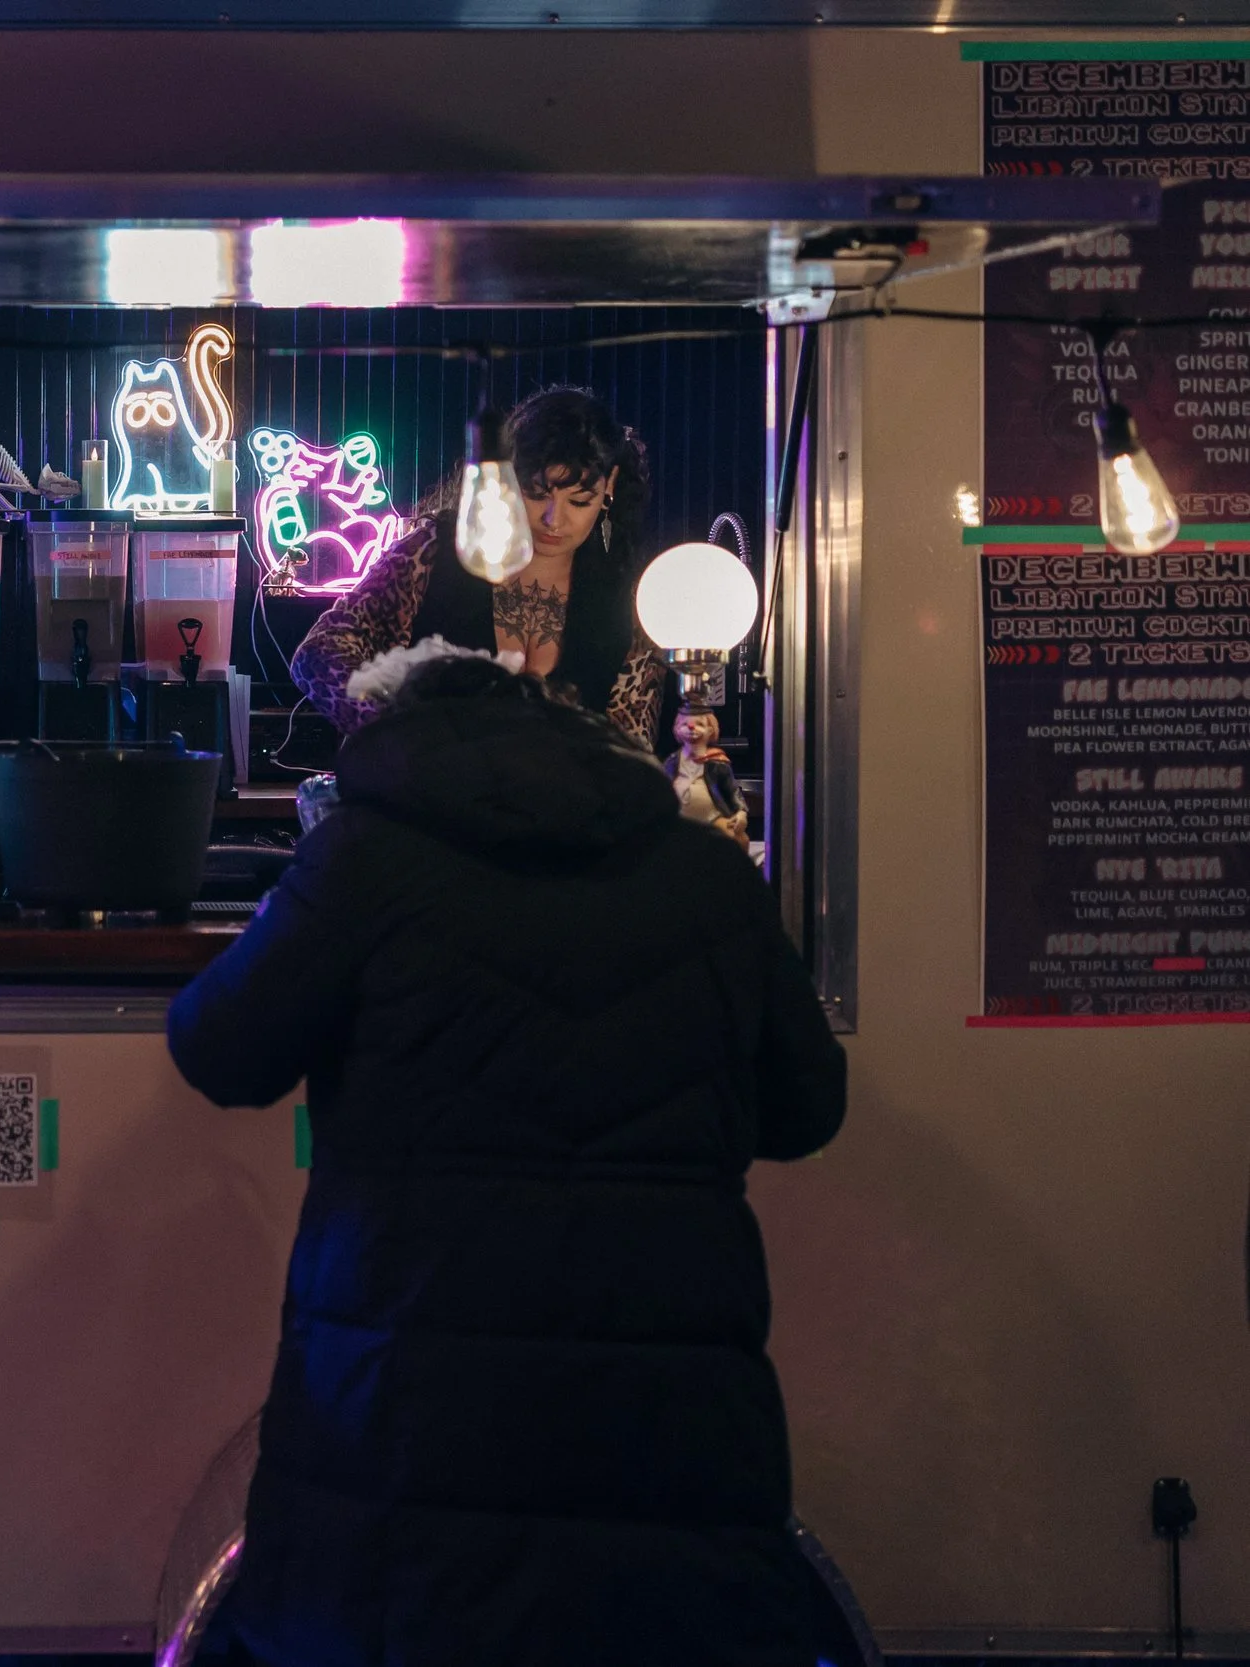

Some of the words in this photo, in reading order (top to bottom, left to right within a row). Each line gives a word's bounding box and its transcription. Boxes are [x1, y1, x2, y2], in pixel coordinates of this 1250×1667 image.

[991, 93, 1170, 118] LIBATION
[1178, 92, 1250, 116] STA
[991, 124, 1139, 146] PREMIUM
[1070, 158, 1094, 178] 2
[1102, 156, 1250, 179] TICKETS
[1049, 265, 1143, 291] SPIRIT
[1192, 265, 1250, 290] MIX
[1175, 354, 1250, 371] GINGER
[1192, 424, 1250, 440] ORAN
[1070, 494, 1095, 517] 2
[990, 587, 1166, 611] LIBATION
[991, 617, 1135, 640] PREMIUM
[1068, 643, 1091, 666] 2
[1100, 641, 1250, 665] TICKETS
[1062, 678, 1108, 703] FAE
[1053, 709, 1097, 720] BELLE
[1101, 708, 1131, 720] ISLE
[1135, 707, 1187, 719] LEMON
[1191, 706, 1250, 718] LAVEND
[1027, 725, 1119, 738] MOONSHINE,
[1123, 723, 1207, 737] LEMONADE,
[1210, 723, 1250, 735] BUTT
[1054, 742, 1082, 754] PEA
[1085, 741, 1145, 753] FLOWER
[1149, 740, 1216, 754] EXTRACT,
[1075, 768, 1145, 793] STILL
[1154, 766, 1243, 791] AWAKE
[1051, 801, 1106, 814] VODKA,
[1109, 799, 1171, 812] KAHLUA,
[1174, 798, 1250, 810] PEPPERMI
[1053, 818, 1091, 829] BARK
[1095, 816, 1179, 829] RUMCHATA,
[1181, 815, 1219, 827] COLD
[1048, 833, 1141, 846] PEPPERMINT
[1145, 832, 1199, 844] MOCHA
[1096, 857, 1146, 882] NYE
[1070, 890, 1136, 904] TEQUILA,
[1139, 889, 1175, 901] BLUE
[1075, 907, 1114, 921] LIME,
[1117, 906, 1168, 920] AGAVE,
[1174, 904, 1245, 917] SPARKLES
[1047, 931, 1181, 956] MIDNIGHT
[1030, 960, 1066, 973] RUM,
[1070, 959, 1118, 971] TRIPLE
[1206, 957, 1250, 969] CRAN
[1090, 974, 1185, 988] STRAWBERRY
[1070, 993, 1094, 1015] 2
